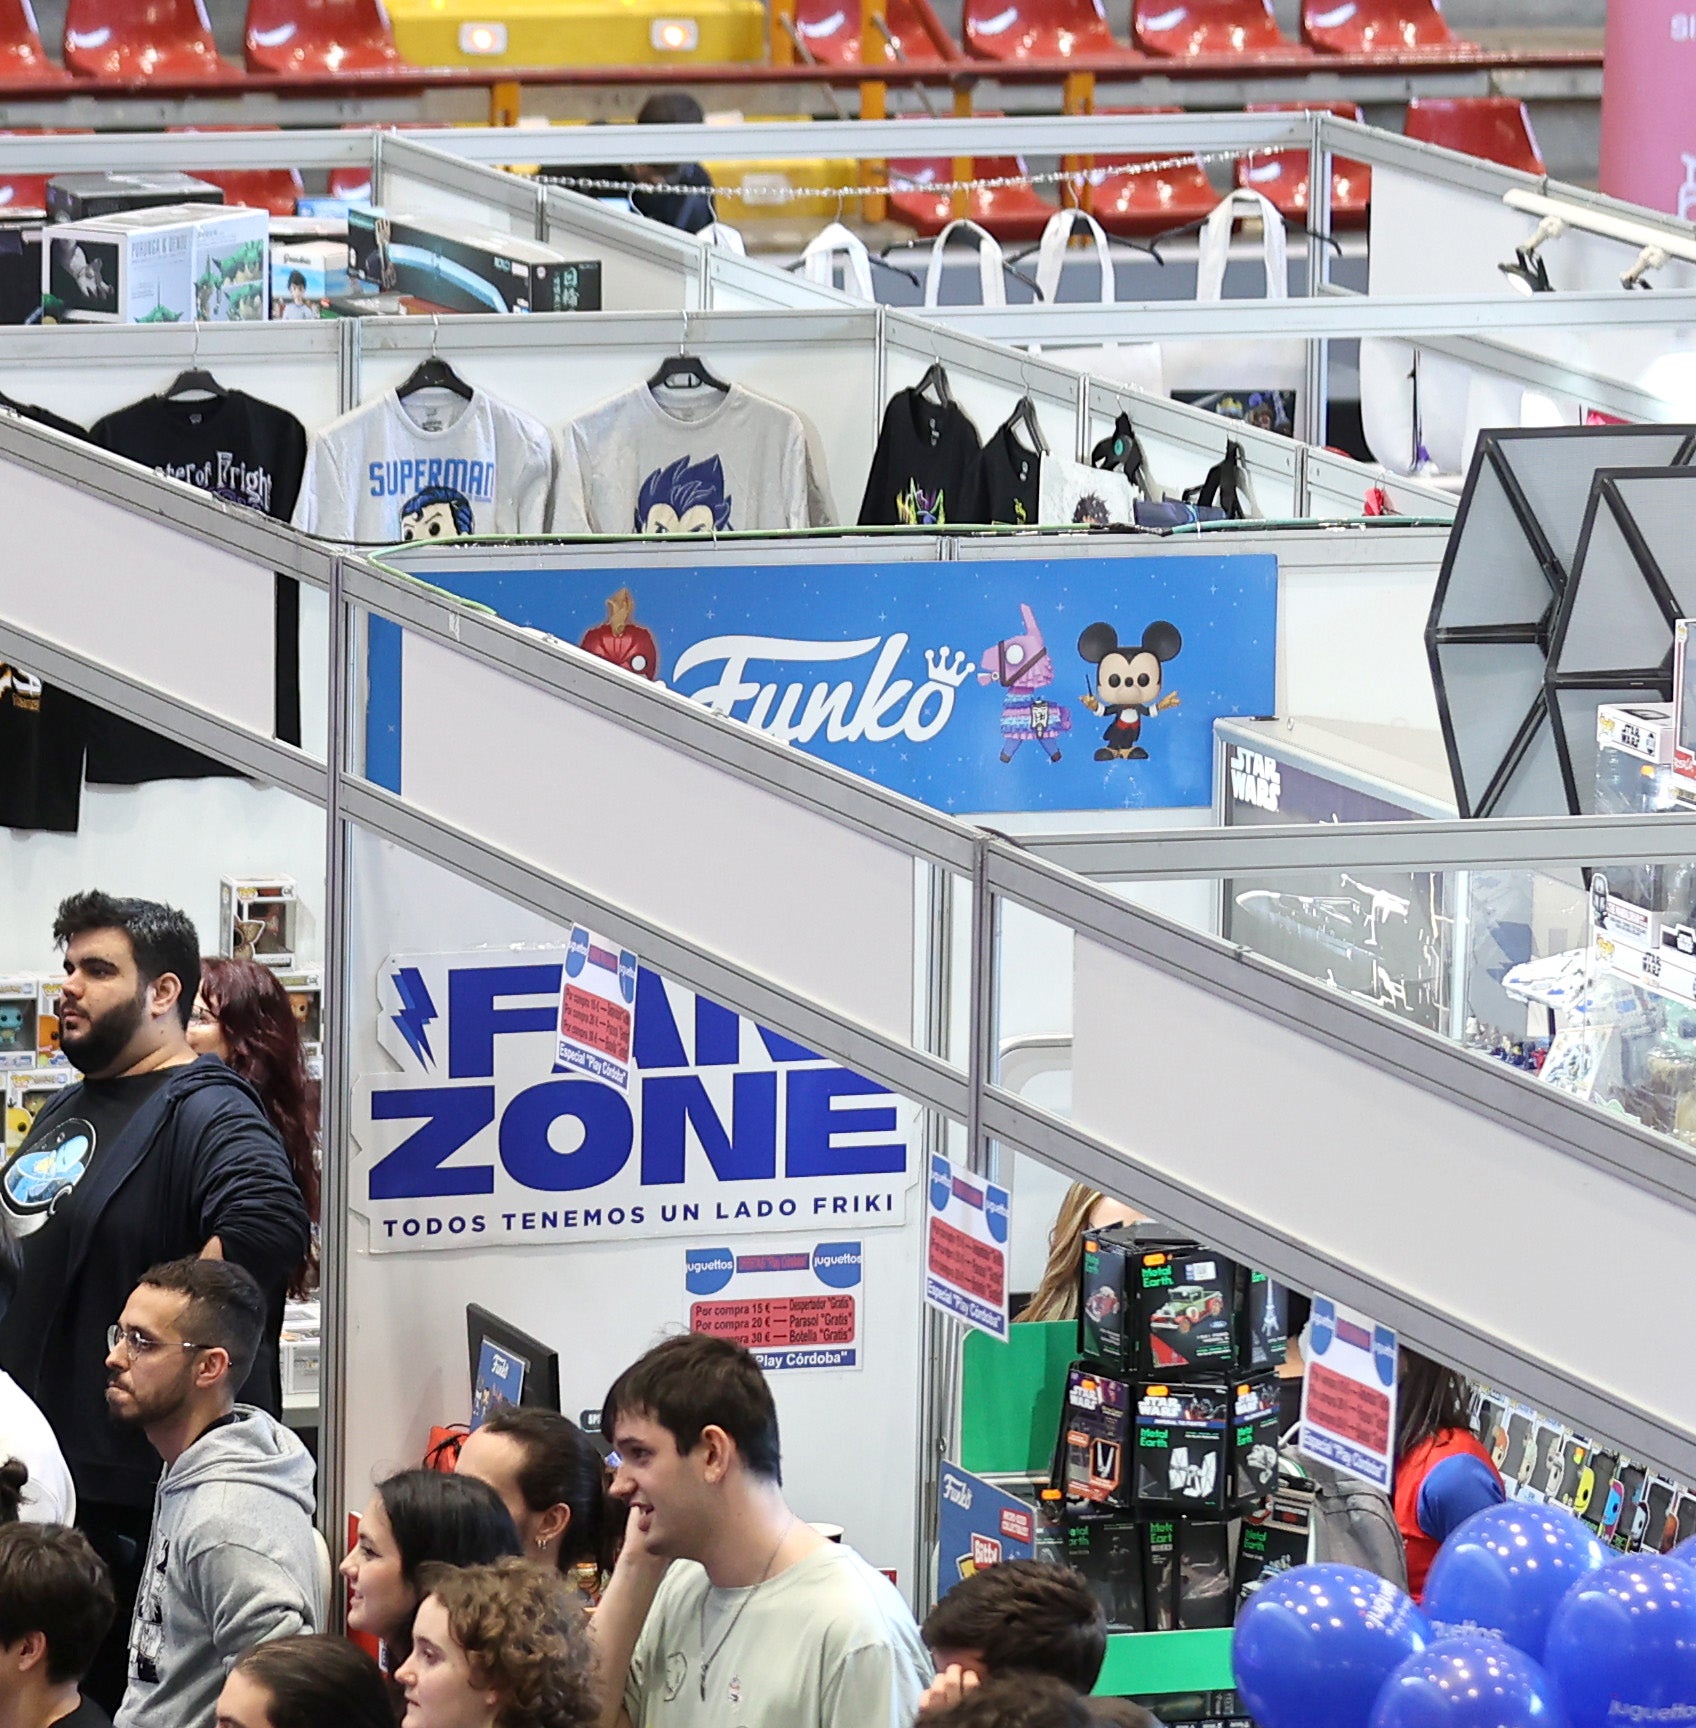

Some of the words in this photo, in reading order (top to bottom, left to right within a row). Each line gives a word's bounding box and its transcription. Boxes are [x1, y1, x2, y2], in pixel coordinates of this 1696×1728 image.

[369, 458, 495, 497] SUPERMAN
[672, 632, 956, 743] Funko
[1230, 746, 1281, 783] STAR
[1230, 769, 1281, 813] WARS
[559, 1041, 585, 1066] Especial
[368, 1070, 907, 1201] ZONE
[384, 1216, 487, 1239] TODOS
[501, 1206, 645, 1232] TENEMOS
[661, 1202, 700, 1223] UN
[716, 1198, 798, 1220] LADO
[813, 1193, 895, 1215] FRIKI
[1140, 1264, 1173, 1278] Metal
[695, 1305, 713, 1317] Por
[714, 1303, 750, 1317] compra
[753, 1302, 764, 1314] 15
[695, 1319, 713, 1331] Por
[714, 1318, 750, 1332] compra
[751, 1317, 764, 1329] 20
[789, 1314, 819, 1328] Parasol
[751, 1332, 763, 1344] 30
[789, 1329, 818, 1343] Botella
[755, 1354, 783, 1369] Play
[785, 1350, 849, 1366] Córdoba"
[1069, 1385, 1099, 1401] STAR
[1141, 1396, 1181, 1408] STAR
[1069, 1396, 1098, 1411] WARS
[1138, 1404, 1182, 1418] WARS
[1140, 1428, 1169, 1439] Metal
[943, 1473, 974, 1511] Funko
